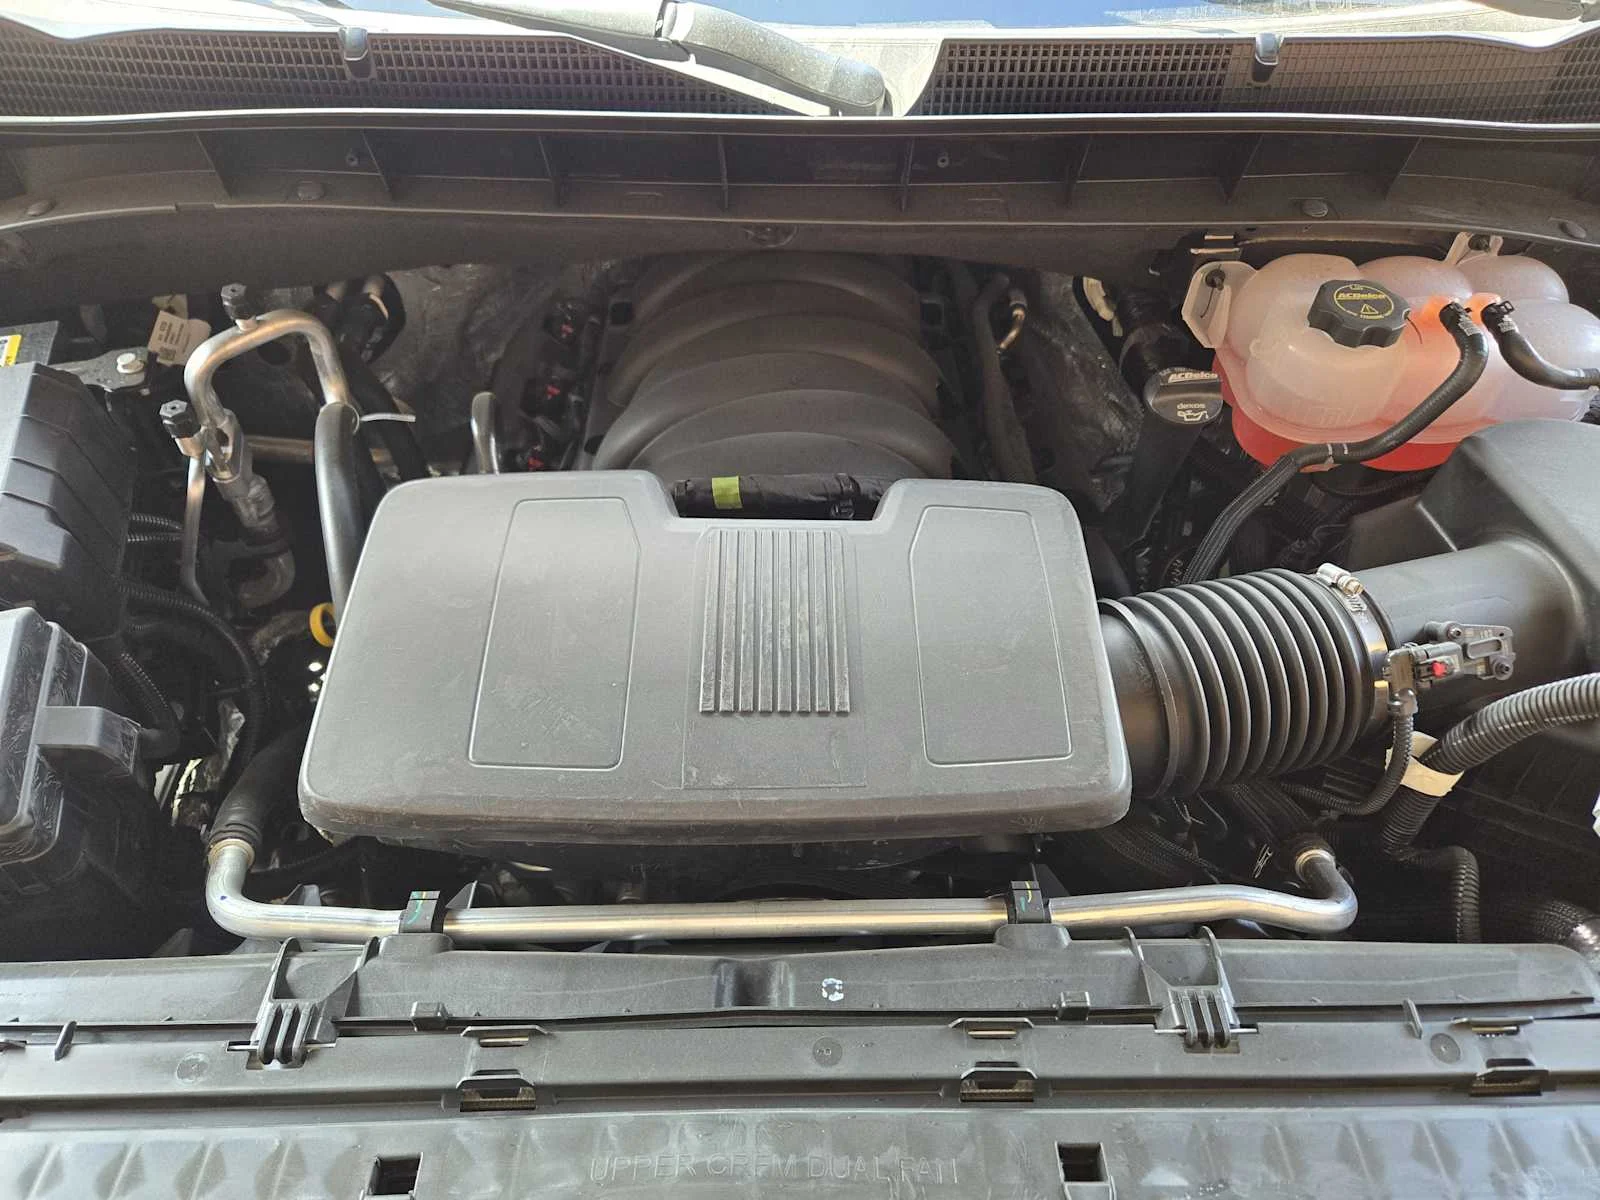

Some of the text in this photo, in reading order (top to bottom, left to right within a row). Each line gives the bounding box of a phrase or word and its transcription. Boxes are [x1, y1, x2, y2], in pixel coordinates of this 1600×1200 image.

[1337, 292, 1385, 301] ACDelco
[1168, 371, 1219, 383] ACDelco
[1177, 402, 1206, 410] dexos
[590, 1152, 697, 1181] UPPER
[807, 1155, 891, 1182] DUAL
